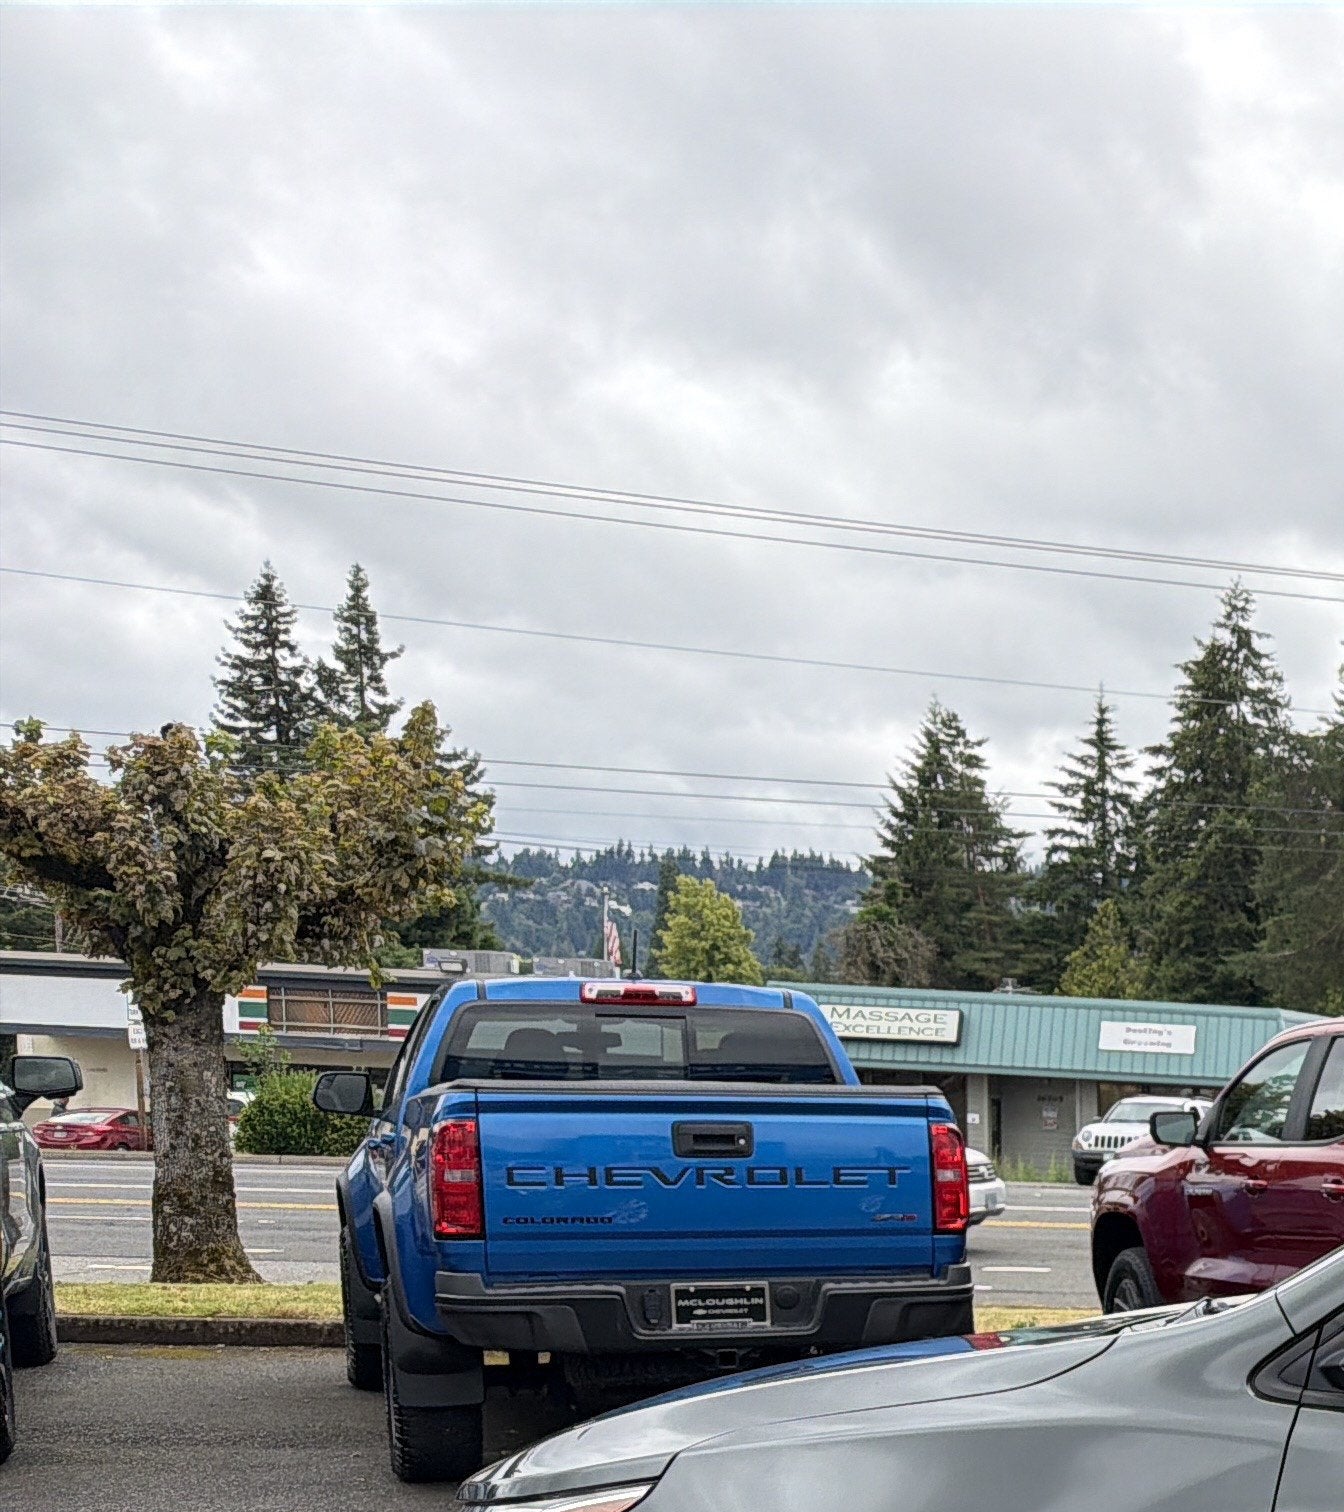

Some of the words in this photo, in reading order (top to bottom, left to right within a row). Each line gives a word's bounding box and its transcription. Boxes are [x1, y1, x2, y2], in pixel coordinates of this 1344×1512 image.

[830, 1007, 948, 1025] MASSAGE
[830, 1021, 946, 1037] EXCELLENCE
[505, 1166, 911, 1189] CHEVROLET
